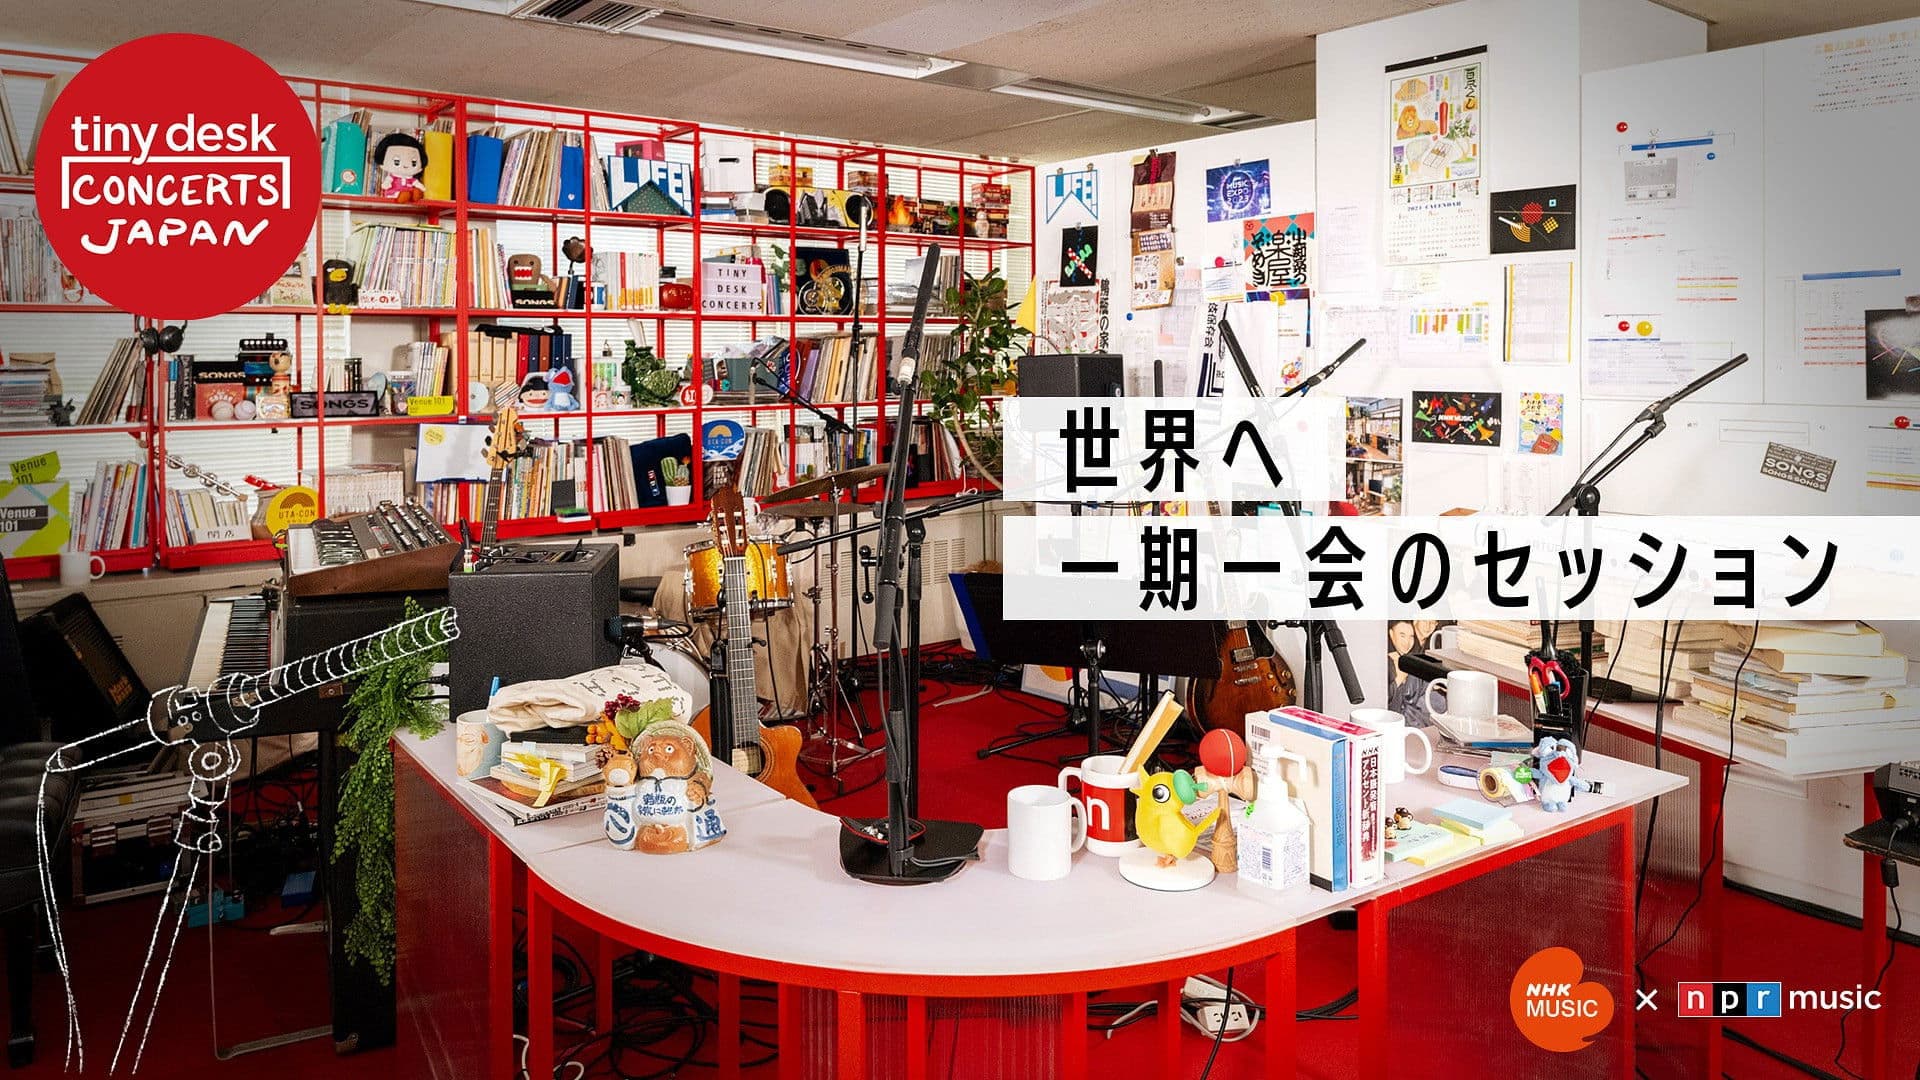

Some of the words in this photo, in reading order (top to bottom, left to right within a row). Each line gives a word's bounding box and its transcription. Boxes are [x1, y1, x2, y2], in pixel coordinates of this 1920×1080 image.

[1227, 179, 1249, 190] MUSIC
[718, 268, 747, 278] TINY
[717, 284, 747, 294] DESK
[515, 298, 555, 306] SONGS
[702, 300, 762, 311] CONCERTS
[198, 371, 247, 379] SONGS
[12, 457, 48, 474] Venue
[1764, 457, 1828, 483] SONGS
[16, 473, 34, 485] 101
[0, 507, 37, 519] Venue
[0, 520, 19, 532] 101
[1361, 746, 1379, 756] NHK
